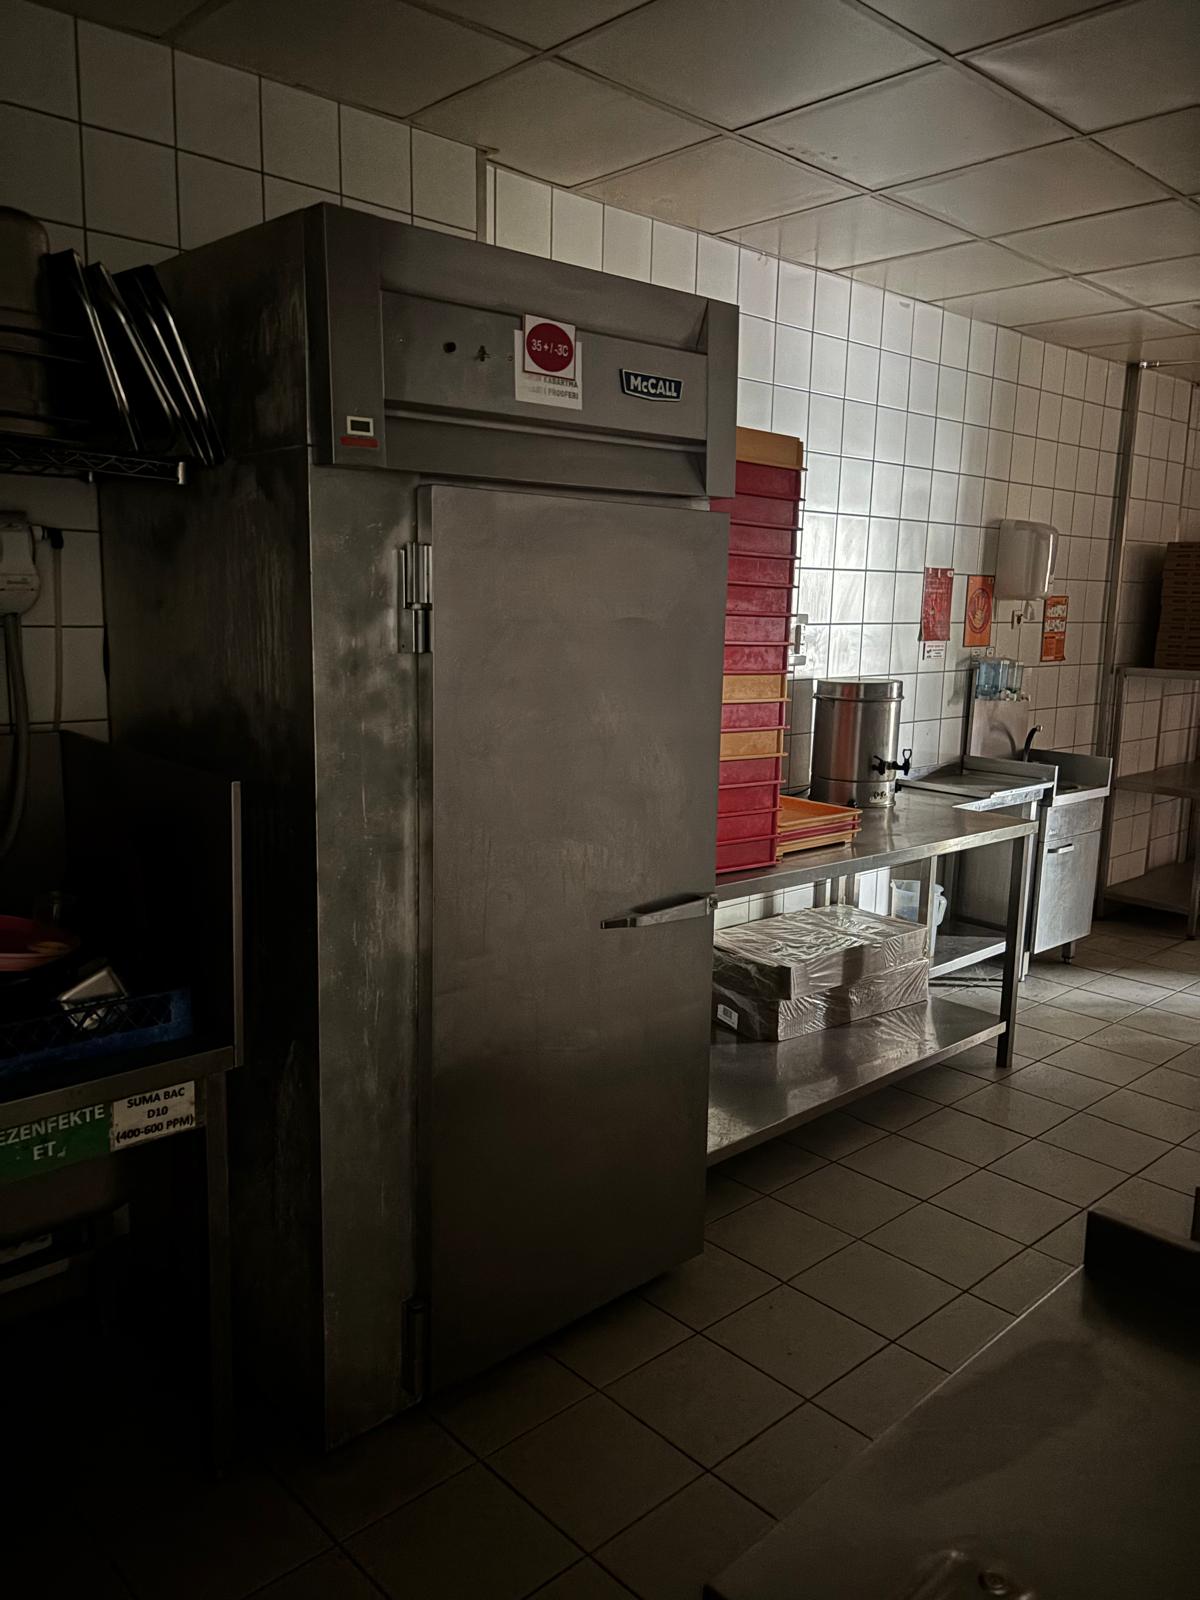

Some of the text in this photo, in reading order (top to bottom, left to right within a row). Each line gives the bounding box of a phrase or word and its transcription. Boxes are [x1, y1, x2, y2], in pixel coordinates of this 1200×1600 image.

[630, 375, 678, 397] McCALL
[127, 1087, 186, 1109] SUMA BAC
[147, 1106, 169, 1119] D10
[116, 1113, 194, 1144] (400-600 PPM)
